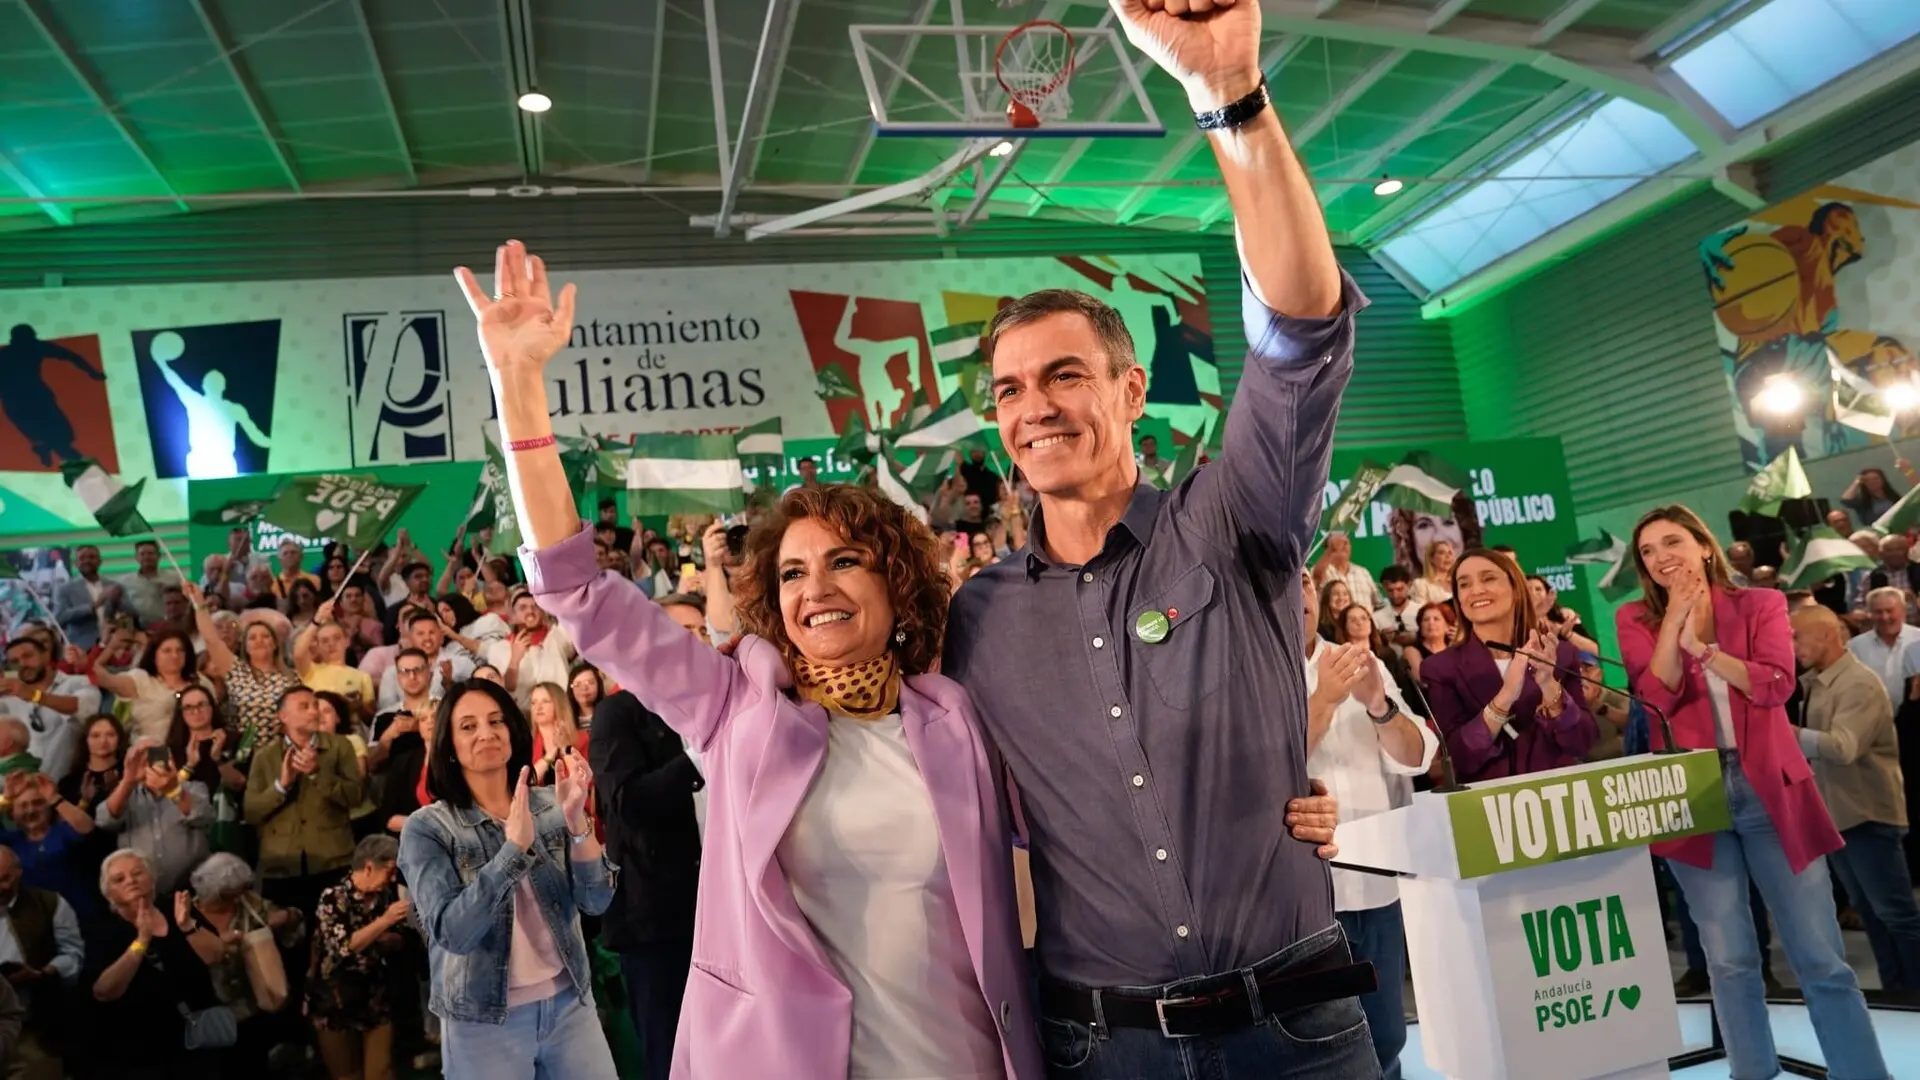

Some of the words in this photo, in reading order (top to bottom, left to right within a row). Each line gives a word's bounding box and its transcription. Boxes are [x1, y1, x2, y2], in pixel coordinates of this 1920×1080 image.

[567, 309, 760, 349] ntamiento
[637, 348, 667, 370] de
[1470, 467, 1495, 497] LO
[1477, 493, 1555, 528] PÚBLICO
[1546, 572, 1577, 592] SOE
[1602, 763, 1688, 807] SANIDAD
[1482, 779, 1605, 865] VOTA
[1607, 798, 1695, 843] PÚBLICA
[1521, 895, 1636, 978] VOTA
[1533, 979, 1593, 1001] Andalucía
[1535, 994, 1597, 1032] PSOE
